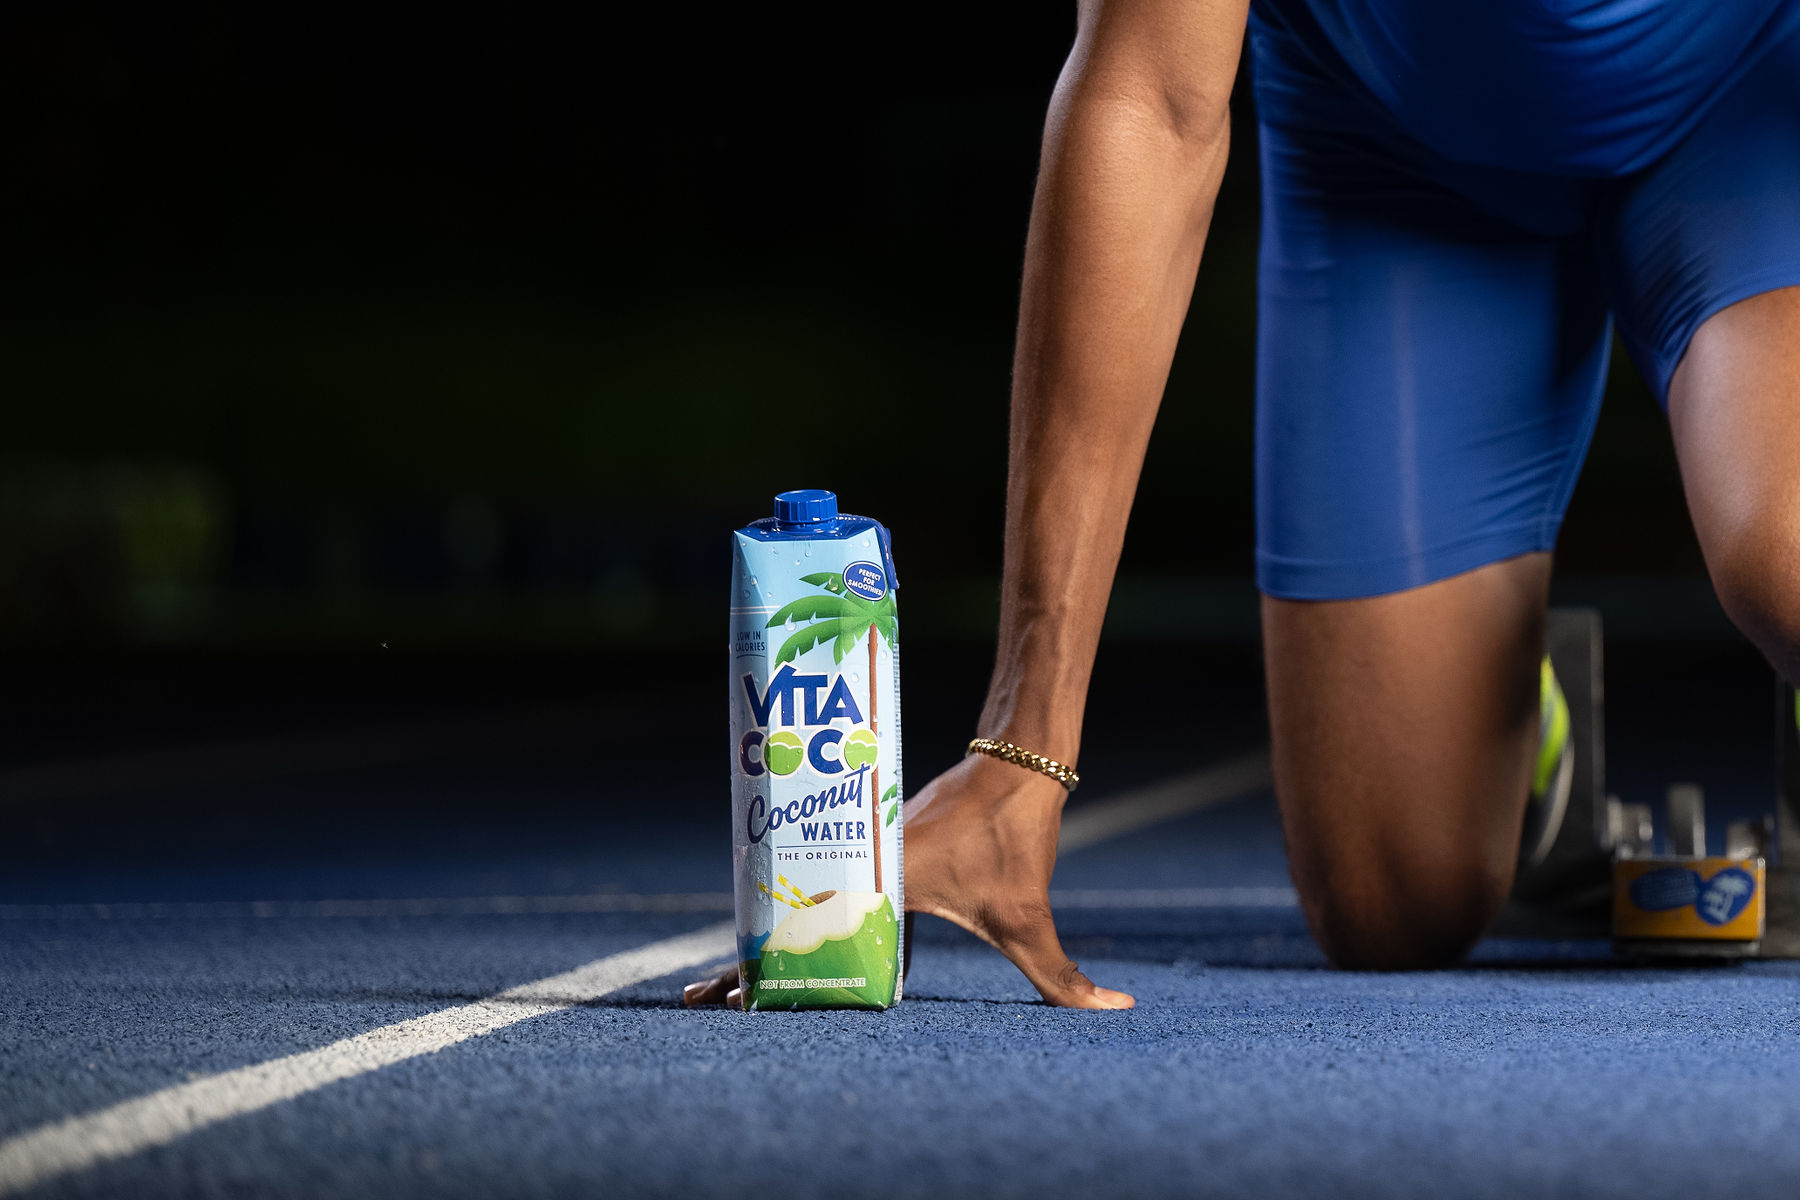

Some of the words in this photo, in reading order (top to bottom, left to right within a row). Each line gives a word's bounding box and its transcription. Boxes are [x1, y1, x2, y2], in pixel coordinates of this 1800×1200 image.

[858, 568, 881, 582] PERFECT
[863, 577, 875, 586] FOR
[736, 631, 751, 641] LOW
[753, 631, 761, 640] IN
[735, 642, 766, 652] CALORIES
[743, 664, 864, 727] VITA
[740, 728, 878, 777] COCO
[748, 762, 871, 844] Coconut
[801, 821, 866, 841] WATER
[778, 852, 800, 861] THE
[805, 850, 868, 860] ORIGINAL
[760, 979, 779, 990] NOT
[779, 979, 805, 989] FROM
[805, 977, 866, 988] CONCENTRATE
